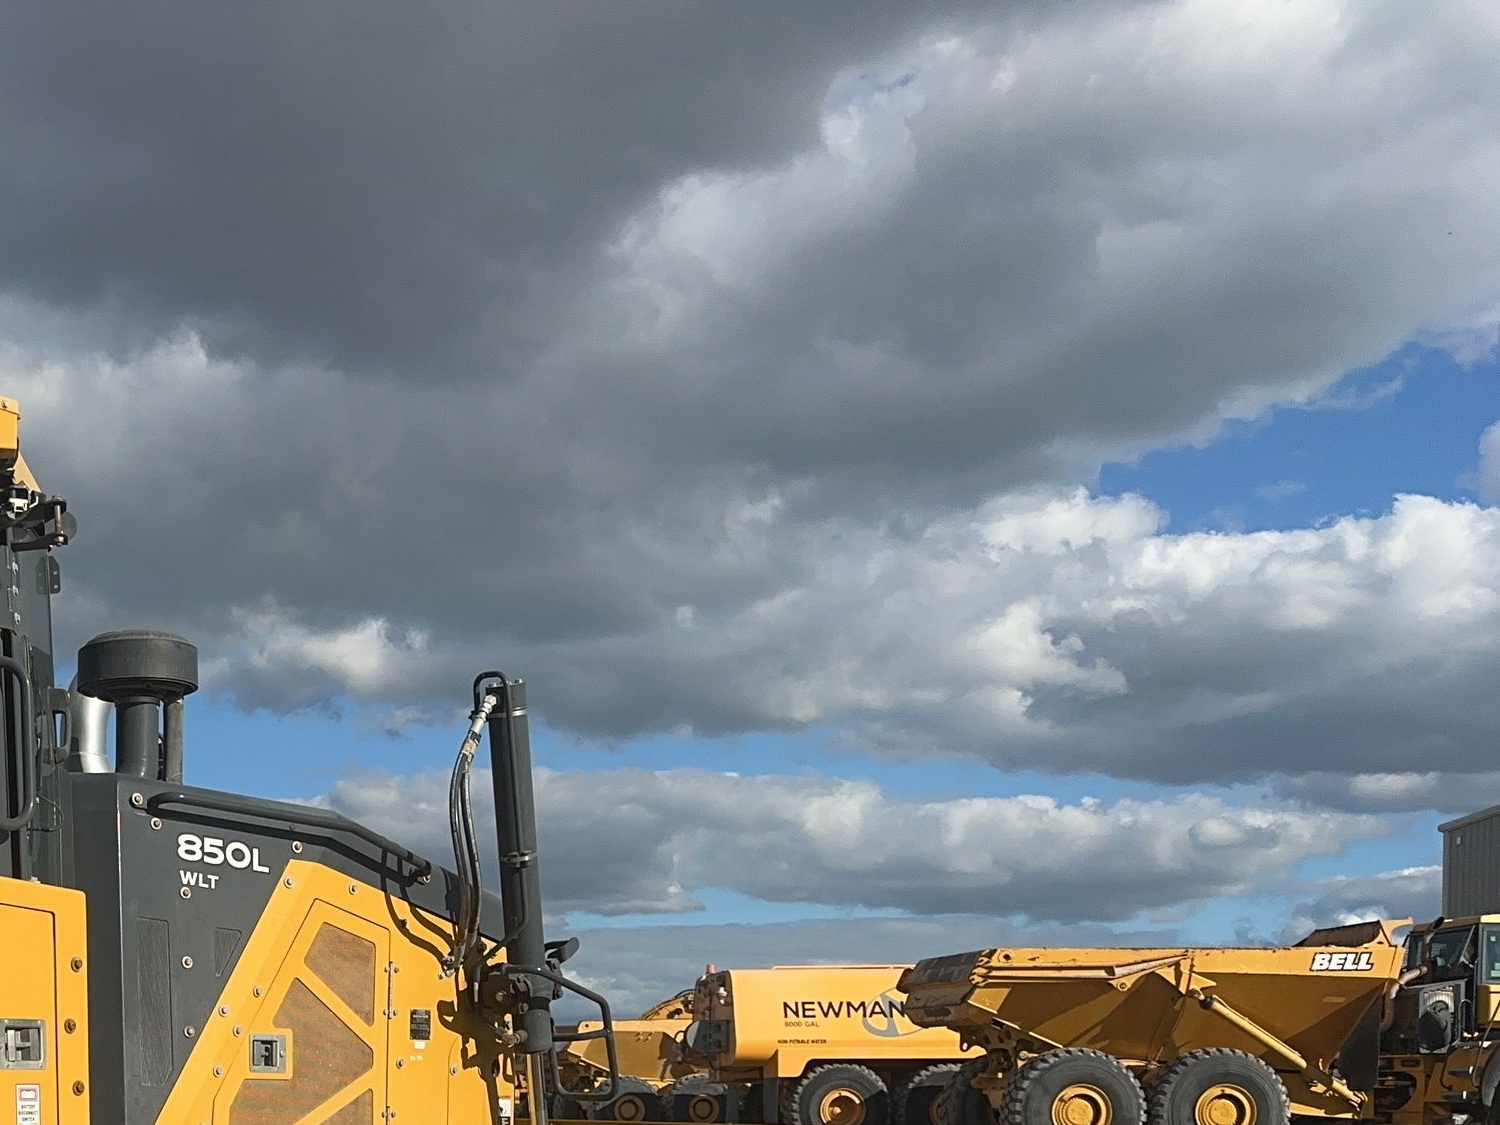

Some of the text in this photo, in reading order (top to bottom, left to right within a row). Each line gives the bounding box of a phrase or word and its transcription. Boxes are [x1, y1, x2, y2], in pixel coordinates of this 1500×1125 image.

[177, 833, 270, 874] 850L
[179, 869, 220, 890] WLT
[1309, 952, 1374, 971] BELL
[783, 1001, 906, 1018] NEWMAN
